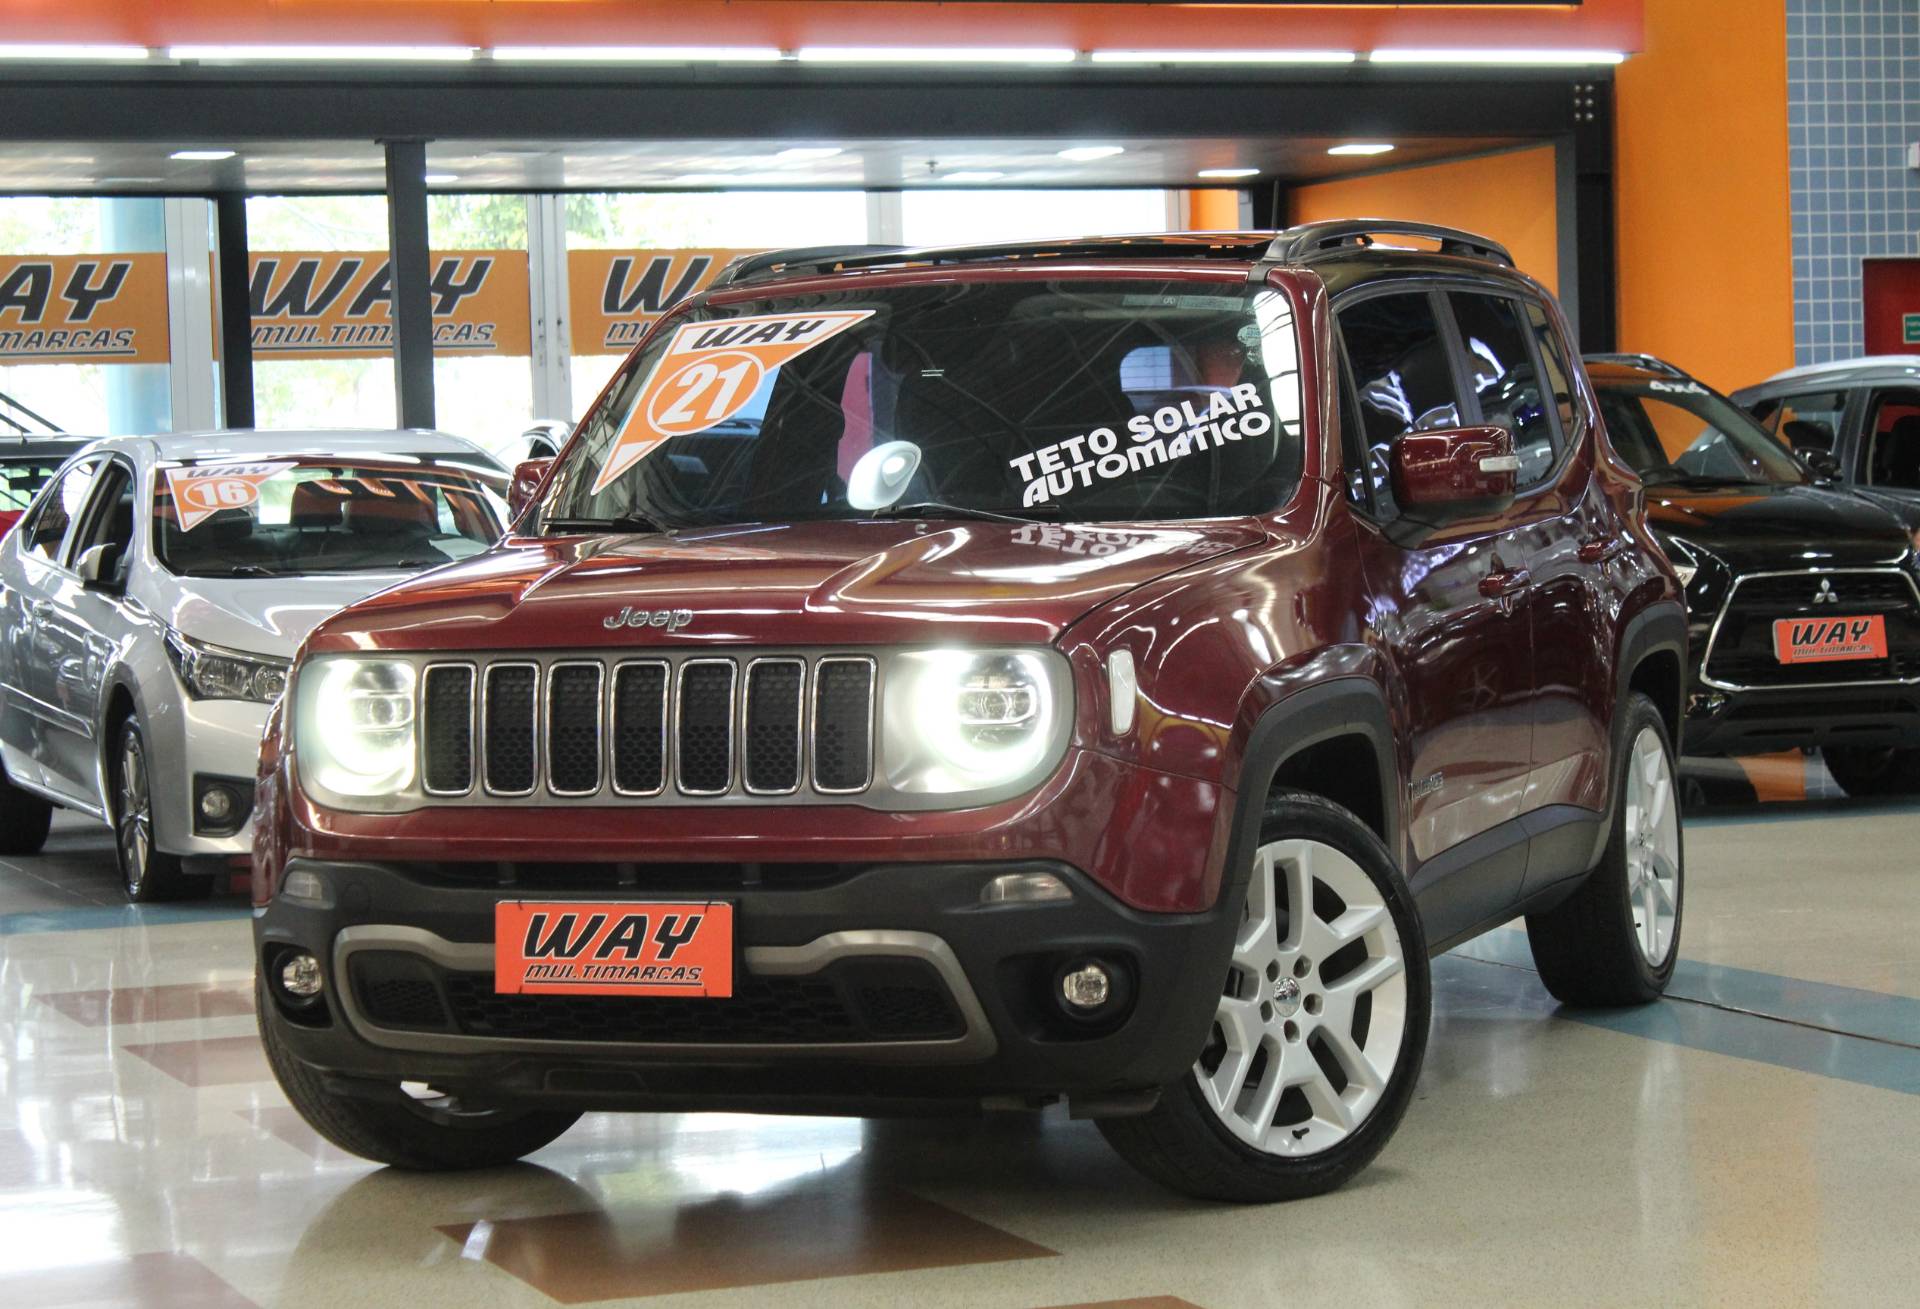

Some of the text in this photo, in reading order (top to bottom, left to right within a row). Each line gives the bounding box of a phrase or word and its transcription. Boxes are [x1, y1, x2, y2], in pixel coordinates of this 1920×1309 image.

[0, 261, 133, 324] AY
[0, 329, 135, 350] MARCAS
[252, 323, 497, 344] MULTIMCAS
[691, 319, 826, 351] WAY
[656, 360, 753, 426] 21
[1009, 382, 1264, 483] TETO SOLAR
[187, 465, 270, 478] WAY
[1022, 411, 1271, 508] AUTOMATICO
[193, 481, 249, 506] 16
[603, 606, 694, 632] Jeep
[1791, 620, 1871, 647] WAY
[522, 912, 704, 961] WAY
